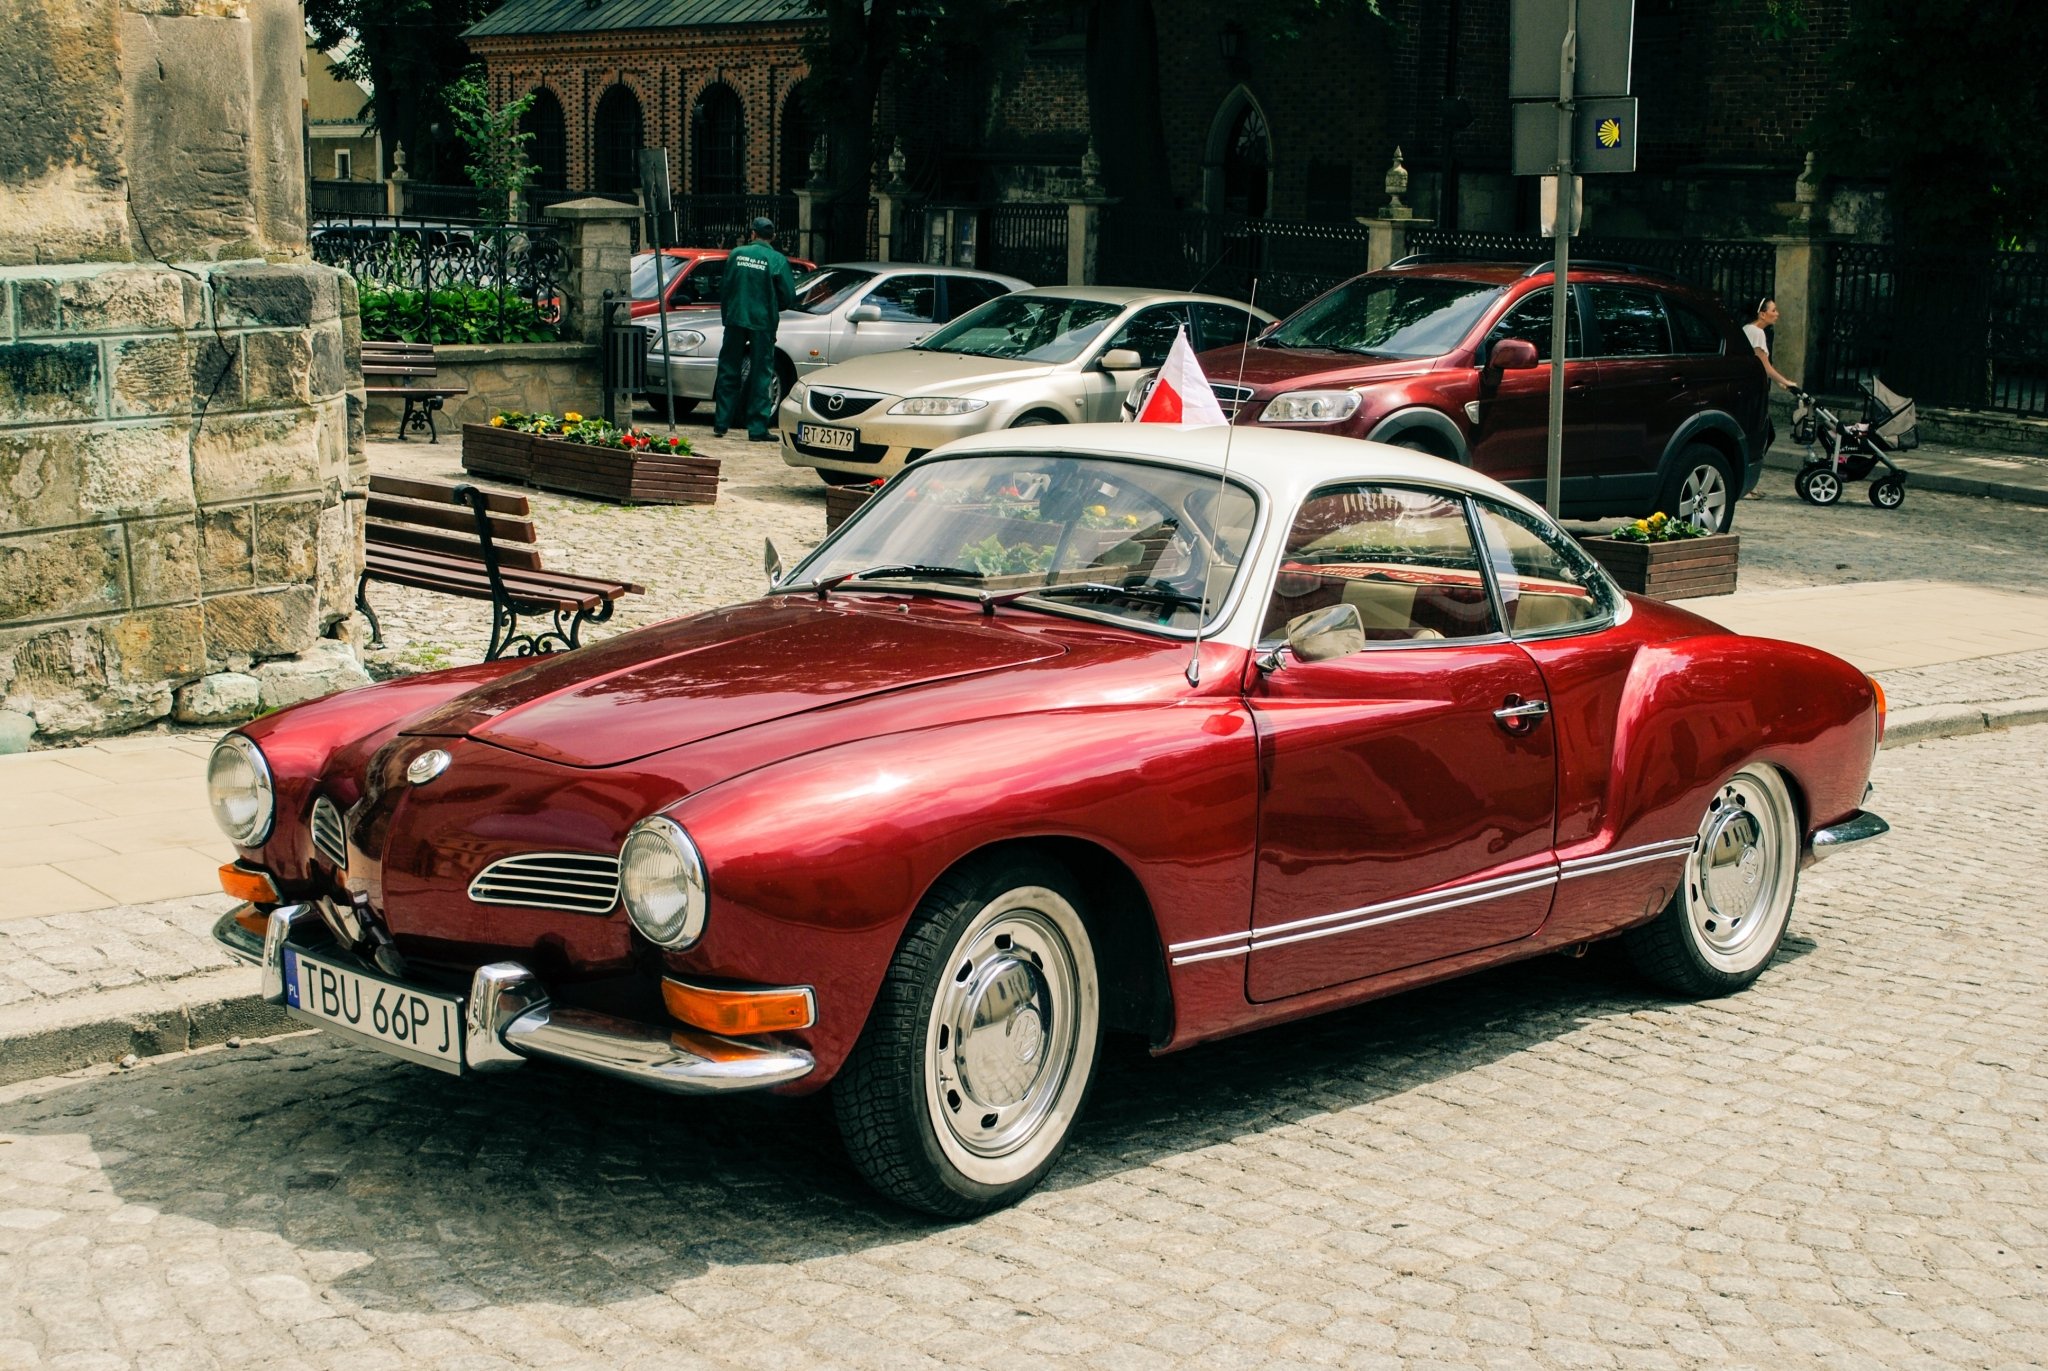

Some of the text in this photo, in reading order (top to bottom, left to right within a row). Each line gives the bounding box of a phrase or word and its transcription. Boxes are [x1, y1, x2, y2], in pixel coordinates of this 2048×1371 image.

[803, 426, 817, 442] RT
[820, 429, 853, 447] 25179
[288, 983, 299, 998] PL
[301, 960, 361, 1024] TBU
